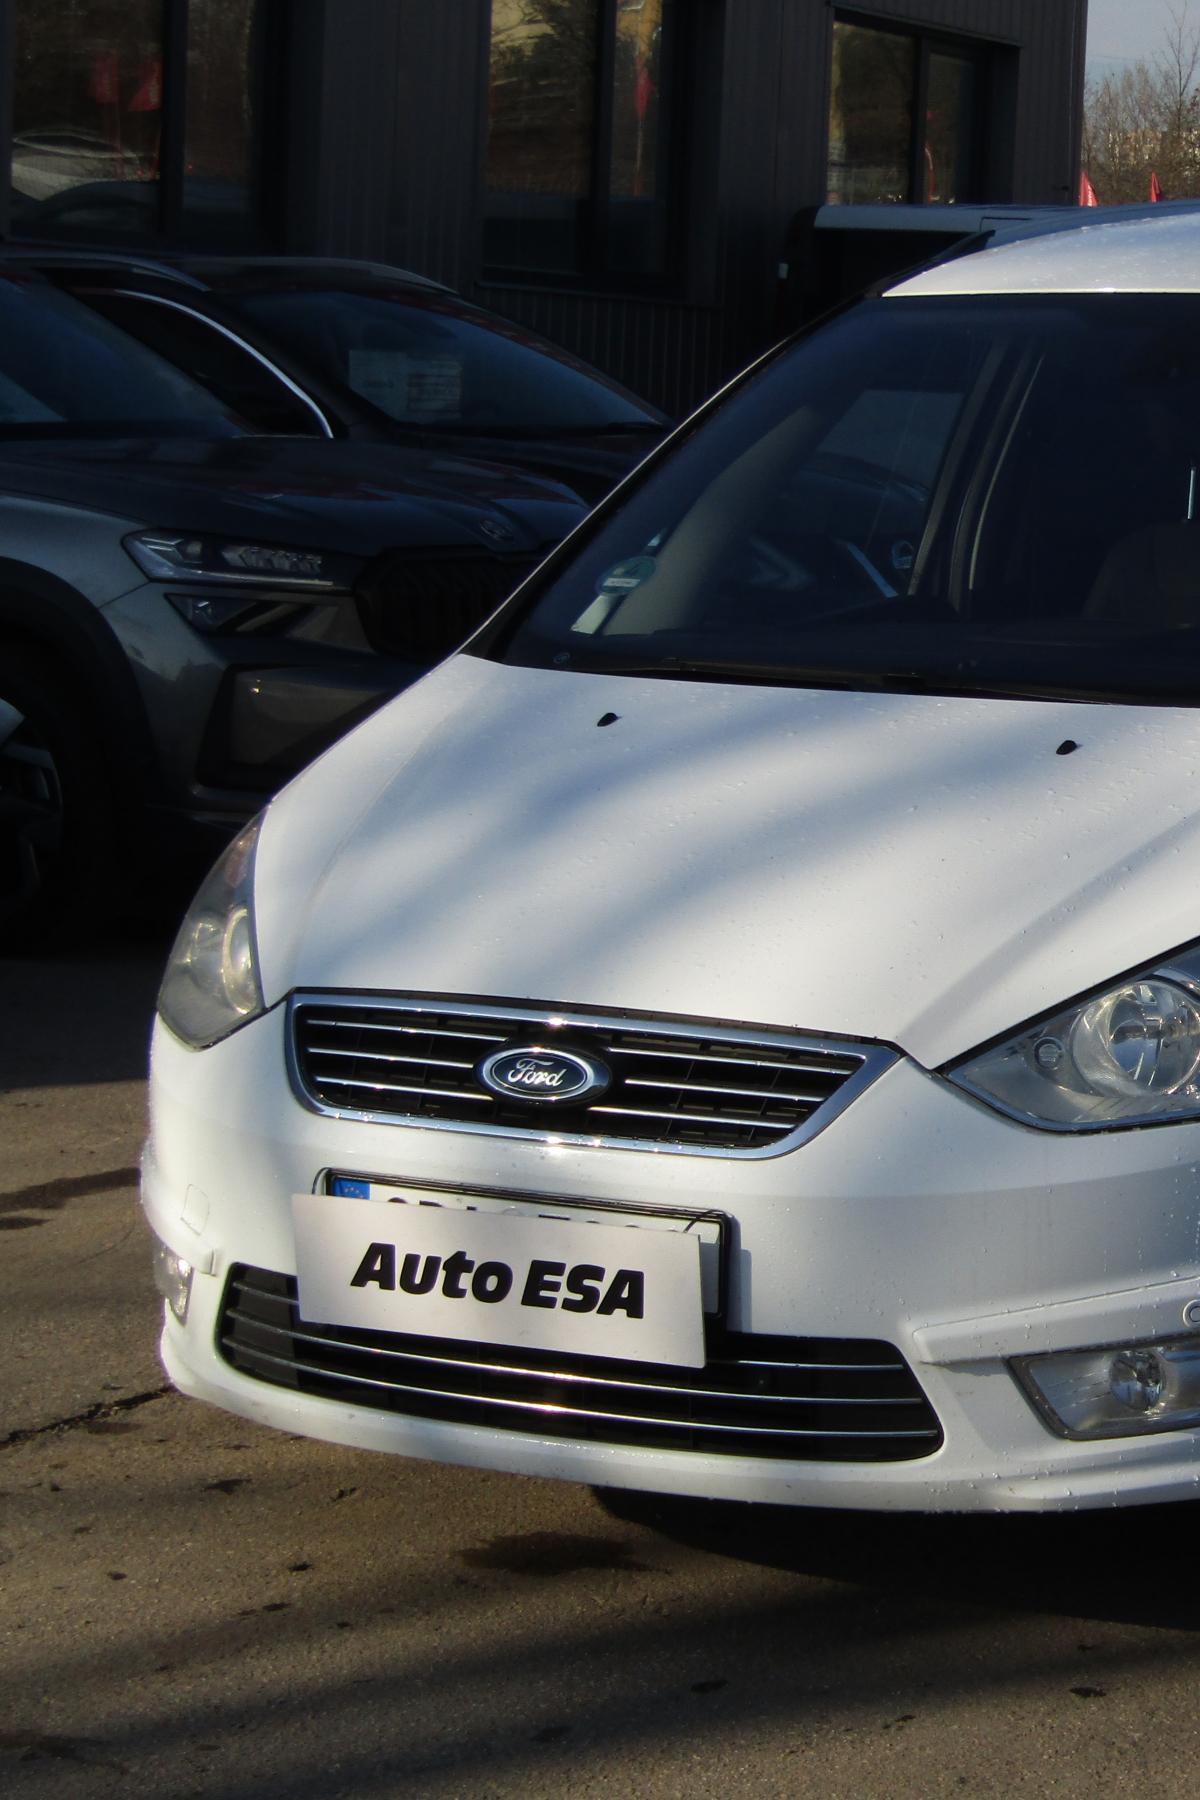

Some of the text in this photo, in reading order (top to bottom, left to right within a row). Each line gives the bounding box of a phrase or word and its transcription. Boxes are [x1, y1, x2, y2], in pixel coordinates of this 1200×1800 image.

[507, 1058, 567, 1087] Ford
[350, 1242, 645, 1319] Auto ESA
